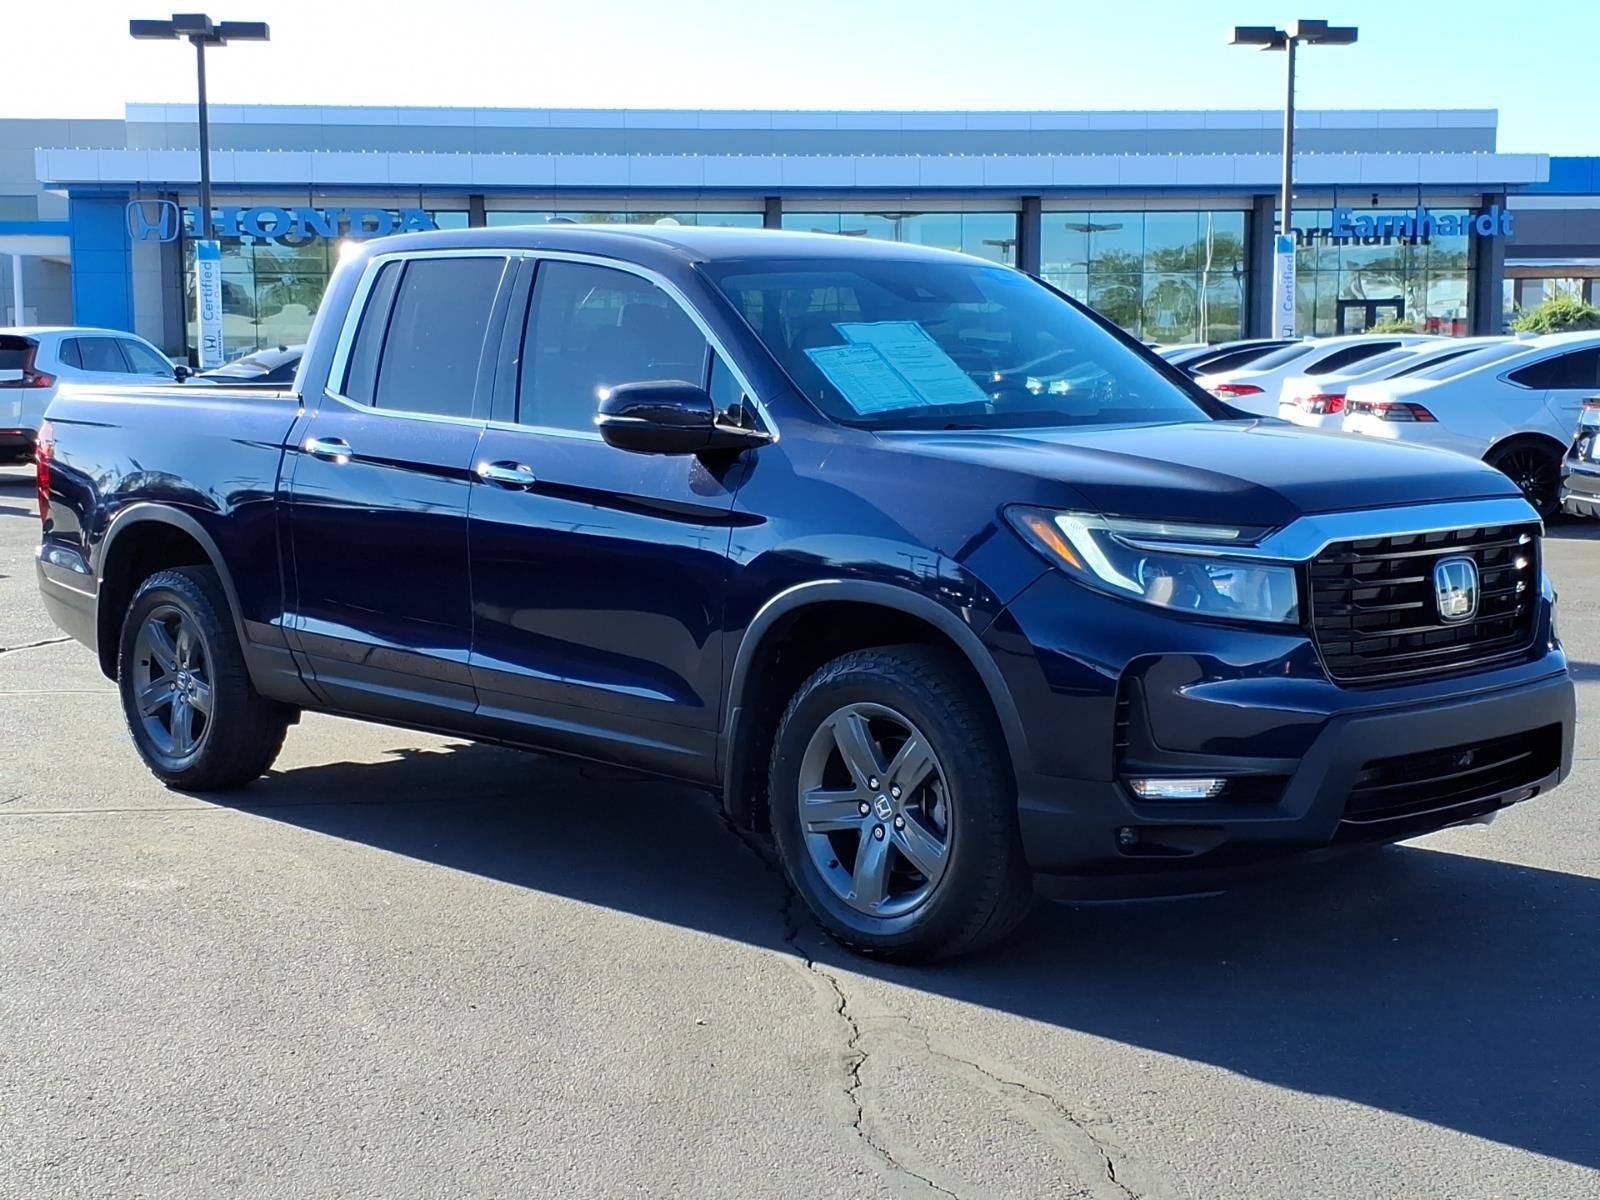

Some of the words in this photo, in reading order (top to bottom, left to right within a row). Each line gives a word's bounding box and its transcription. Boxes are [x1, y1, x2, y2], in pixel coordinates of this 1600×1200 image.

[186, 206, 437, 238] HONDA
[1332, 205, 1514, 237] Earnhardt
[202, 262, 214, 321] Certified
[1283, 254, 1294, 312] Certified
